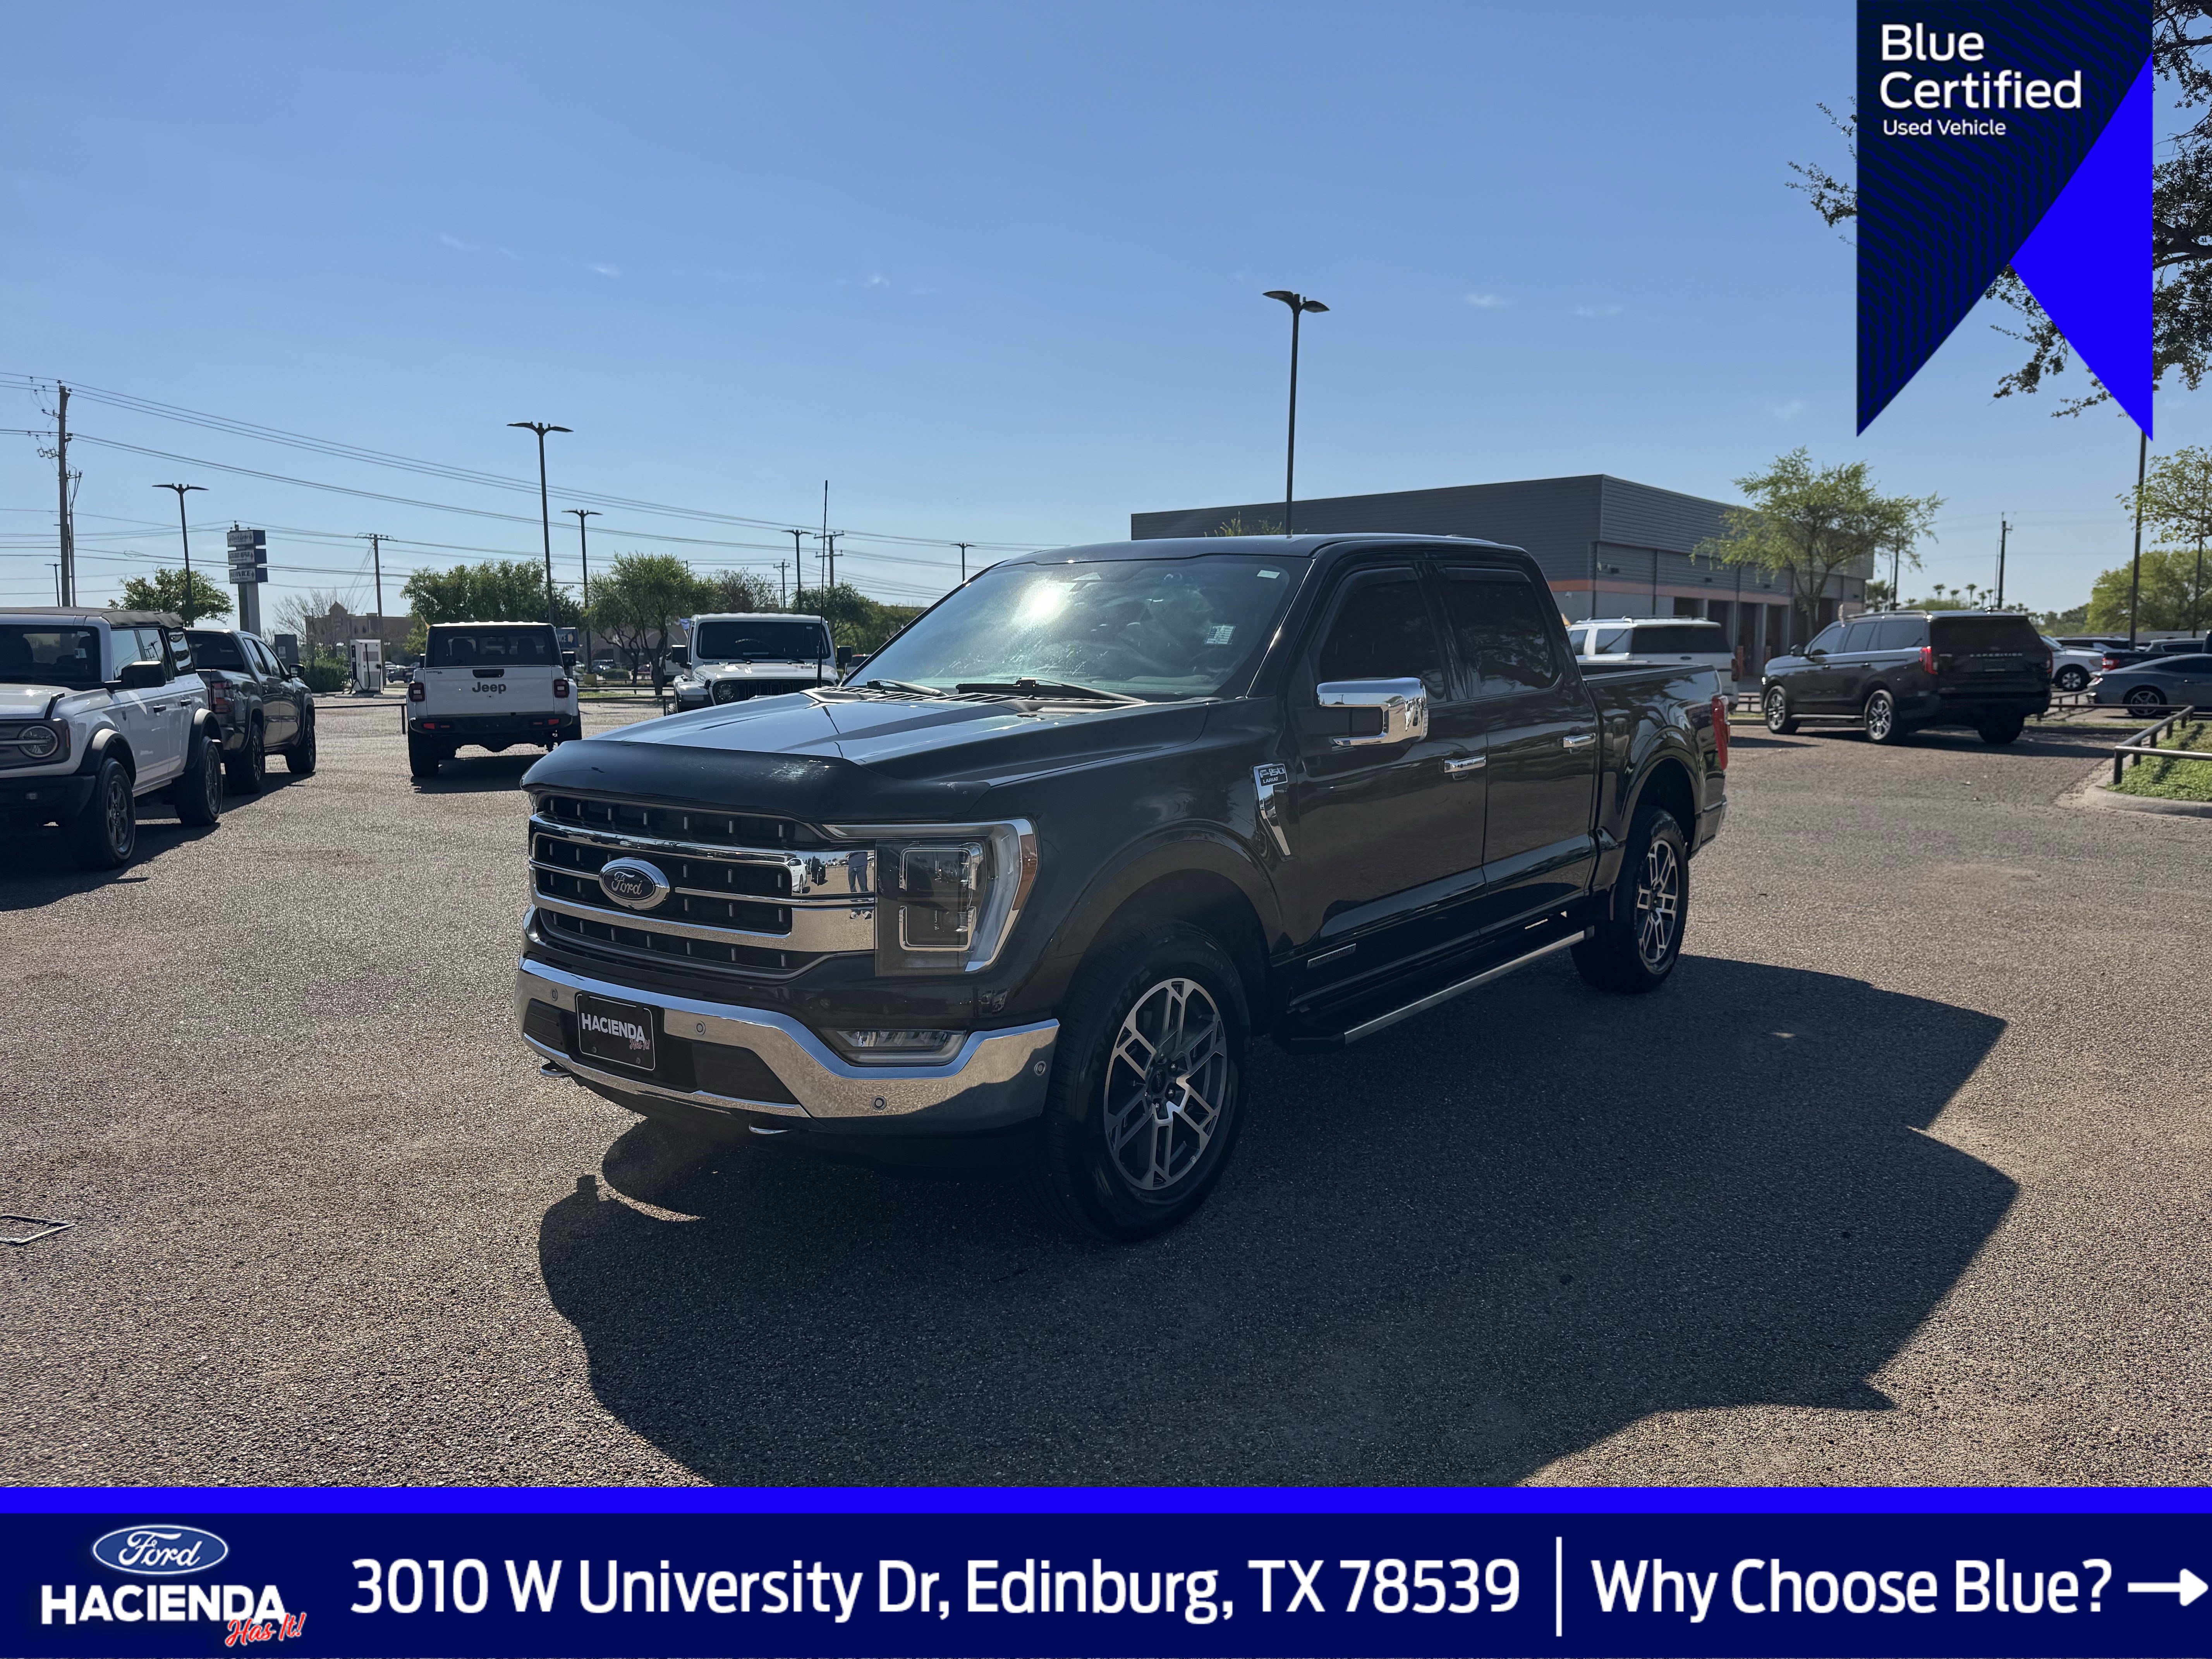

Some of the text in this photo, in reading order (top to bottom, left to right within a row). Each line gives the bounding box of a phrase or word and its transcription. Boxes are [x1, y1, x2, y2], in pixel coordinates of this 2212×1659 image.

[472, 682, 507, 694] Jeep
[1259, 767, 1286, 778] F-150
[611, 871, 643, 895] Ford
[581, 1013, 646, 1043] HACIENDA
[629, 1038, 643, 1050] Has
